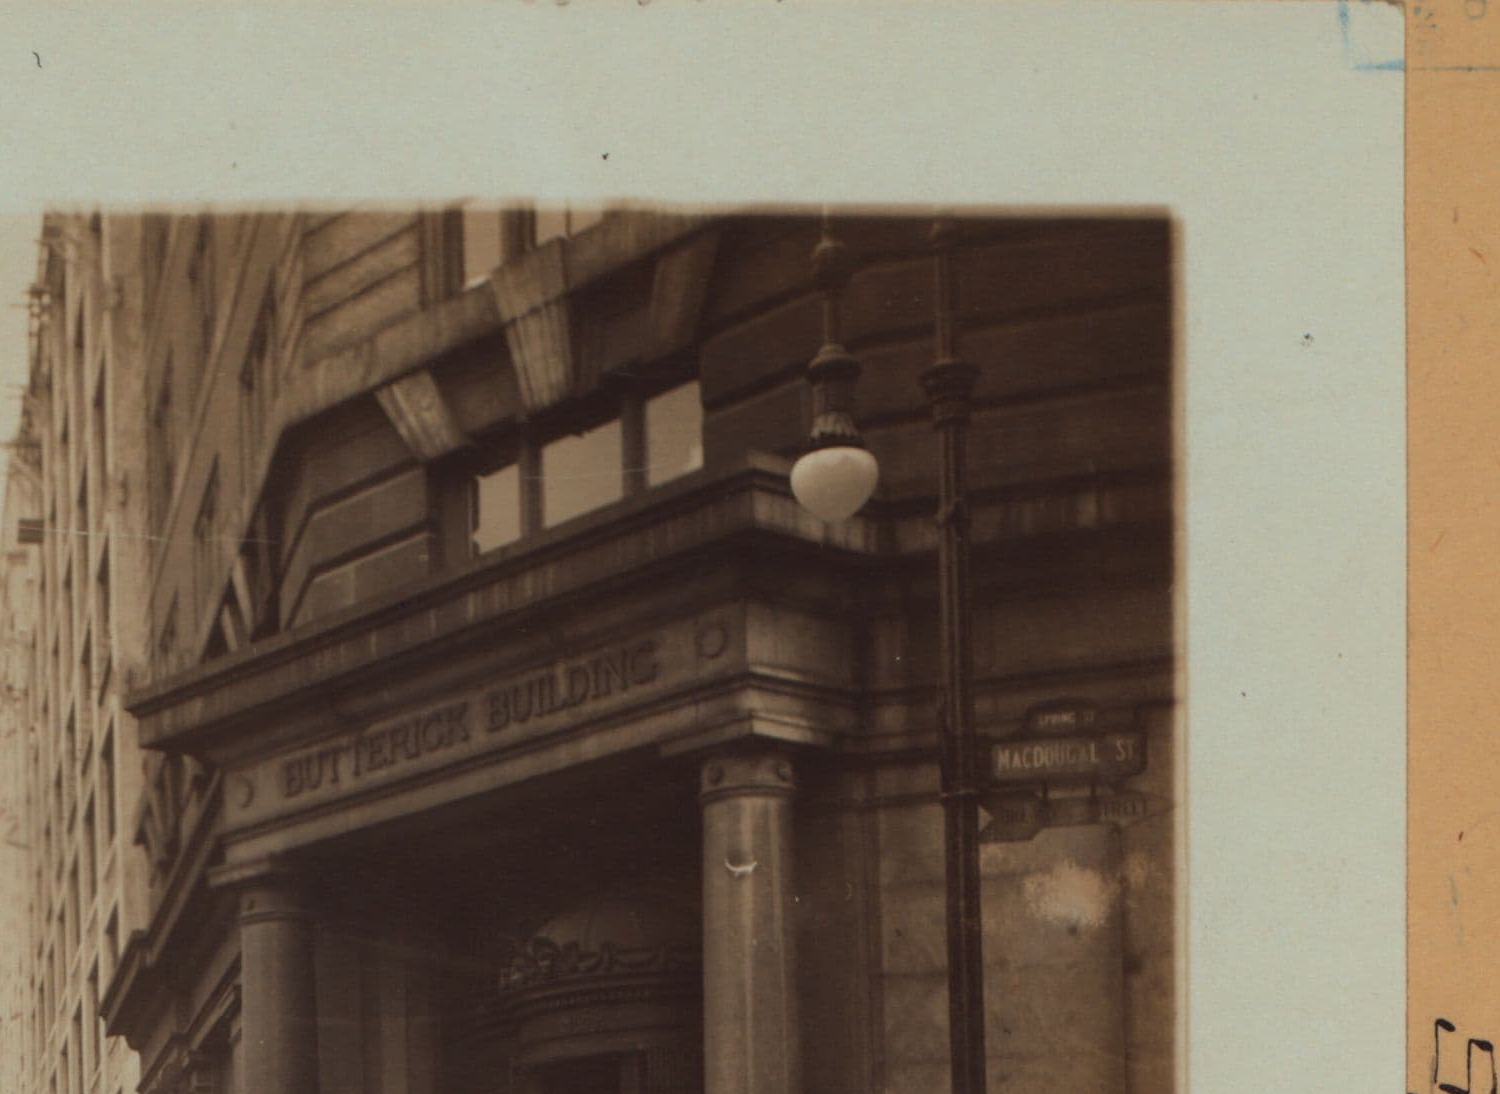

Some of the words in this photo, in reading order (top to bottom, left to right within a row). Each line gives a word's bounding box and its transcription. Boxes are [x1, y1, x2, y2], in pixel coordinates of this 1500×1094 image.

[283, 703, 473, 798] BUTTERICK
[487, 639, 658, 733] BUILDING
[997, 741, 1100, 770] MACDOUGAL
[1115, 737, 1137, 762] ST
